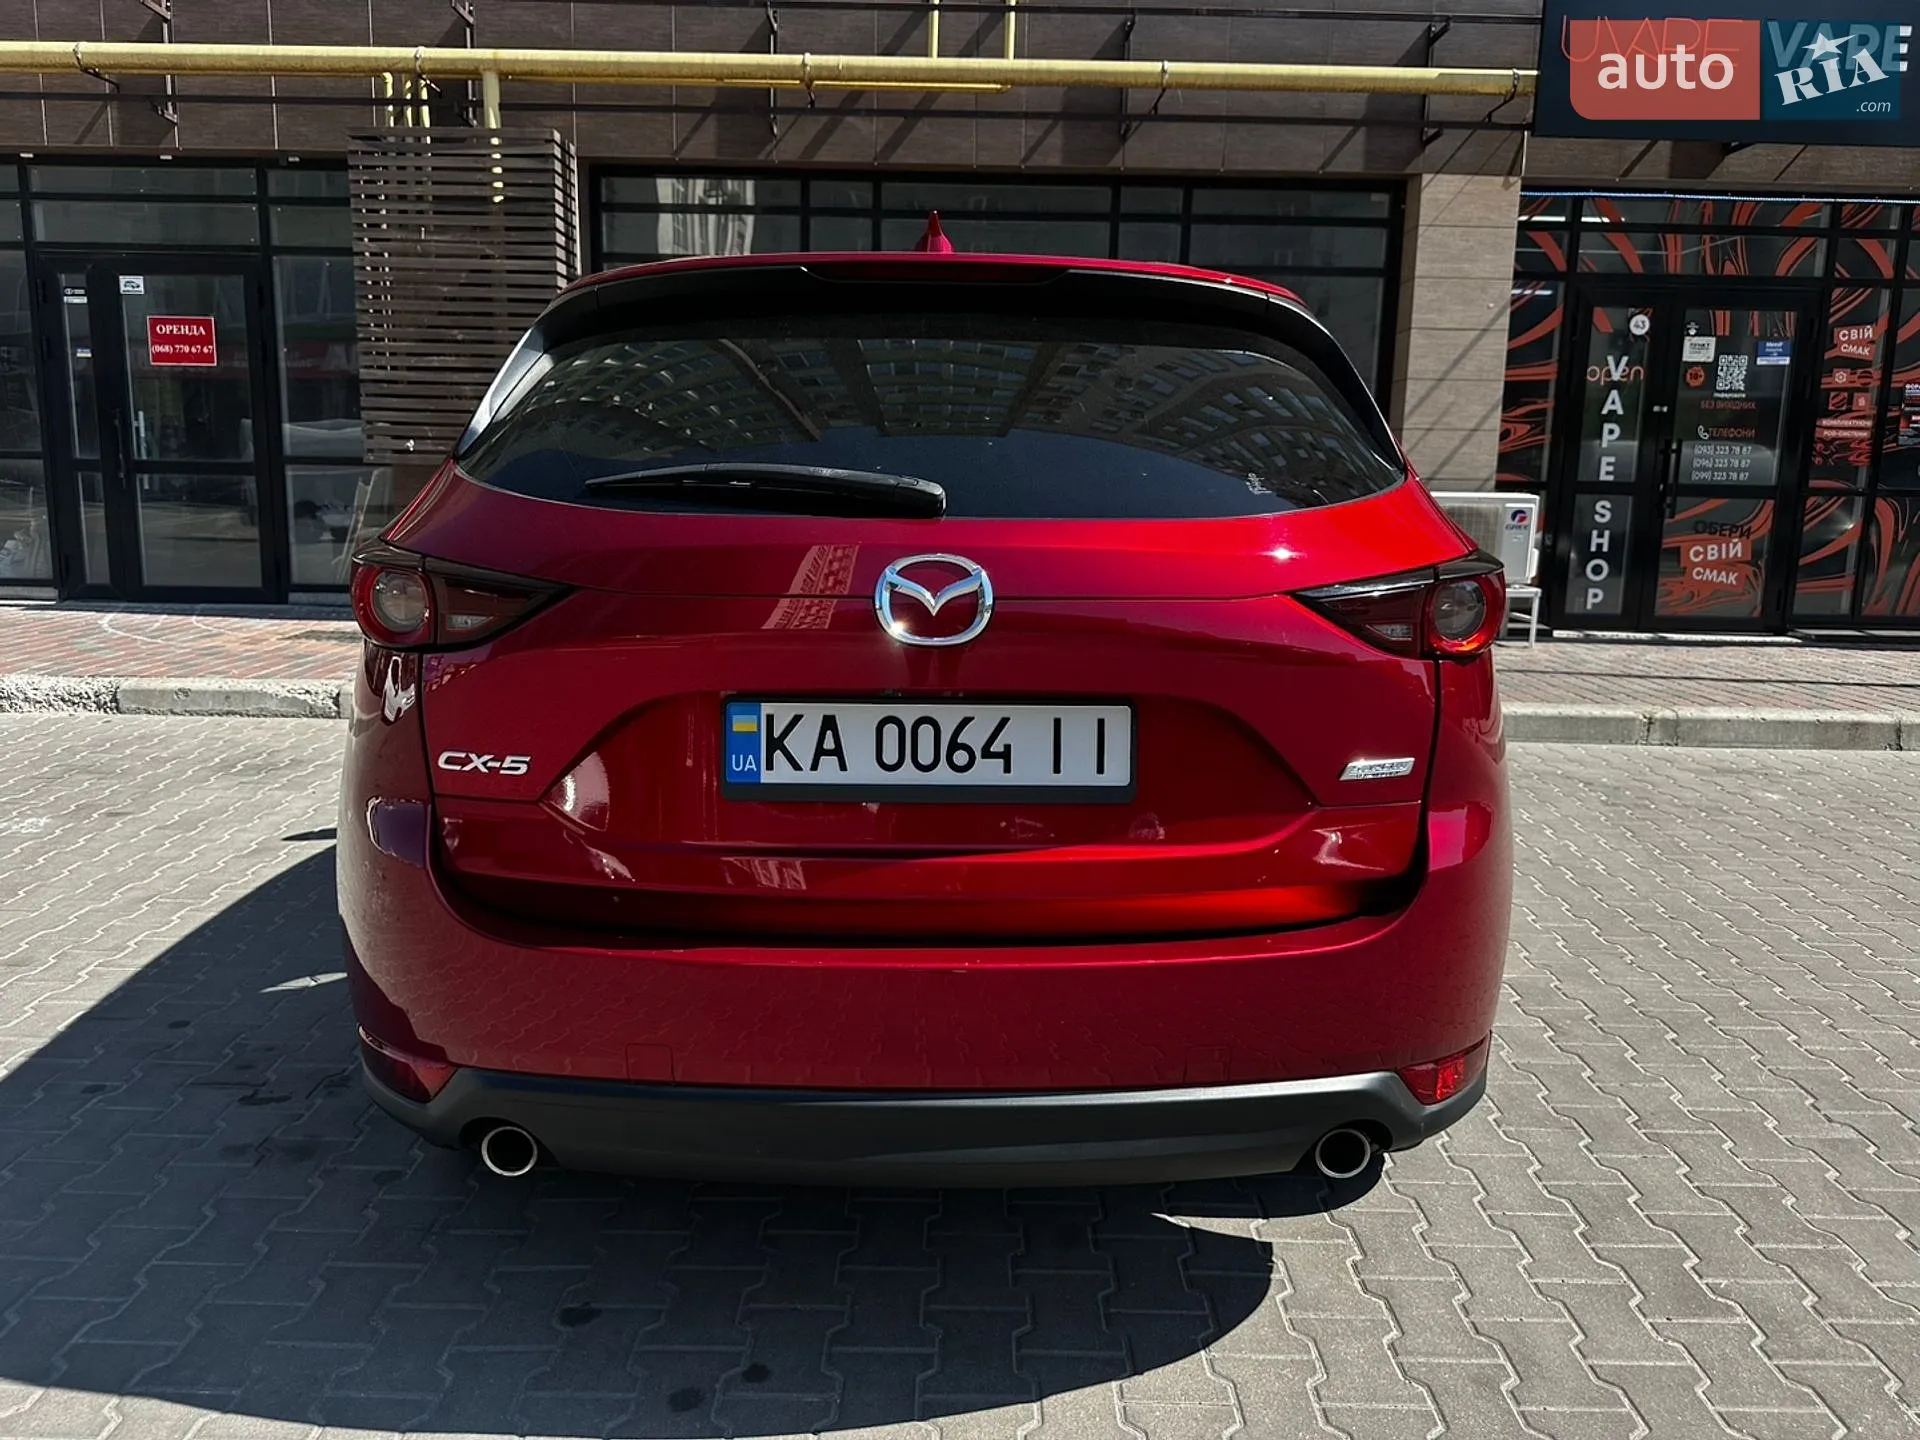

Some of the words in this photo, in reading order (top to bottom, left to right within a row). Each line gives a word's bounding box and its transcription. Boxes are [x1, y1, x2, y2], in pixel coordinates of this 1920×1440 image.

[1766, 21, 1913, 72] VAPE
[156, 324, 206, 336] ОРЕНДА
[1839, 325, 1873, 341] СВІЙ
[152, 343, 173, 354] (068)
[174, 344, 190, 353] 770
[191, 344, 201, 353] 67
[202, 345, 214, 354] 67
[1841, 344, 1870, 356] СМАК
[1599, 355, 1629, 481] VAPE
[1708, 427, 1755, 438] ТЕЛЕФОНИ
[1731, 446, 1740, 455] 78
[1742, 446, 1752, 455] 87
[1729, 459, 1739, 468] 78
[1740, 459, 1751, 468] 87
[1728, 472, 1738, 481] 78
[1739, 472, 1749, 481] 87
[1694, 520, 1752, 540] ОБЕРИ
[1585, 499, 1613, 610] SHOP
[1689, 538, 1742, 562] СВІЙ
[1692, 567, 1738, 586] СМАК
[765, 713, 849, 773] KA
[874, 714, 1012, 775] 0064
[438, 750, 532, 776] CX-5
[731, 754, 758, 772] UA
